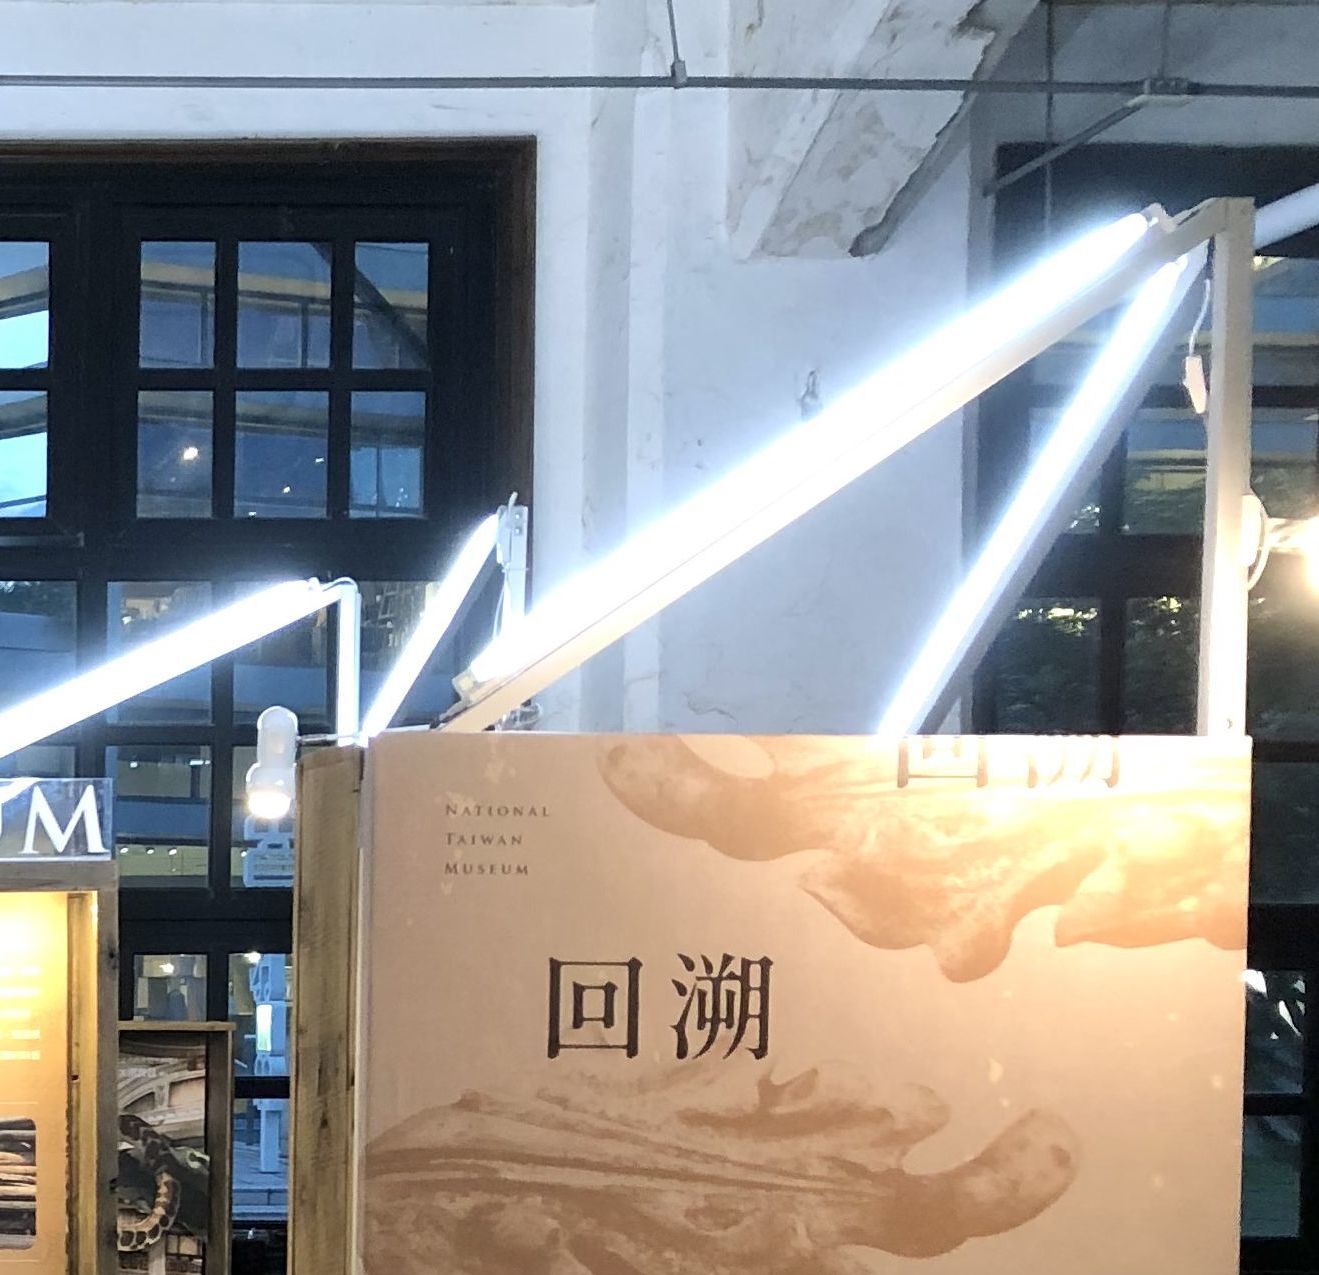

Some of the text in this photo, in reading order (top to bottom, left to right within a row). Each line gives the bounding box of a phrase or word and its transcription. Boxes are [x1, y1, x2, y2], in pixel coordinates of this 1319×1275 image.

[444, 803, 550, 817] NATIONAL
[445, 832, 522, 846] TAIWAN
[444, 861, 529, 876] MUSEUM
[546, 951, 774, 1061] 回溯
